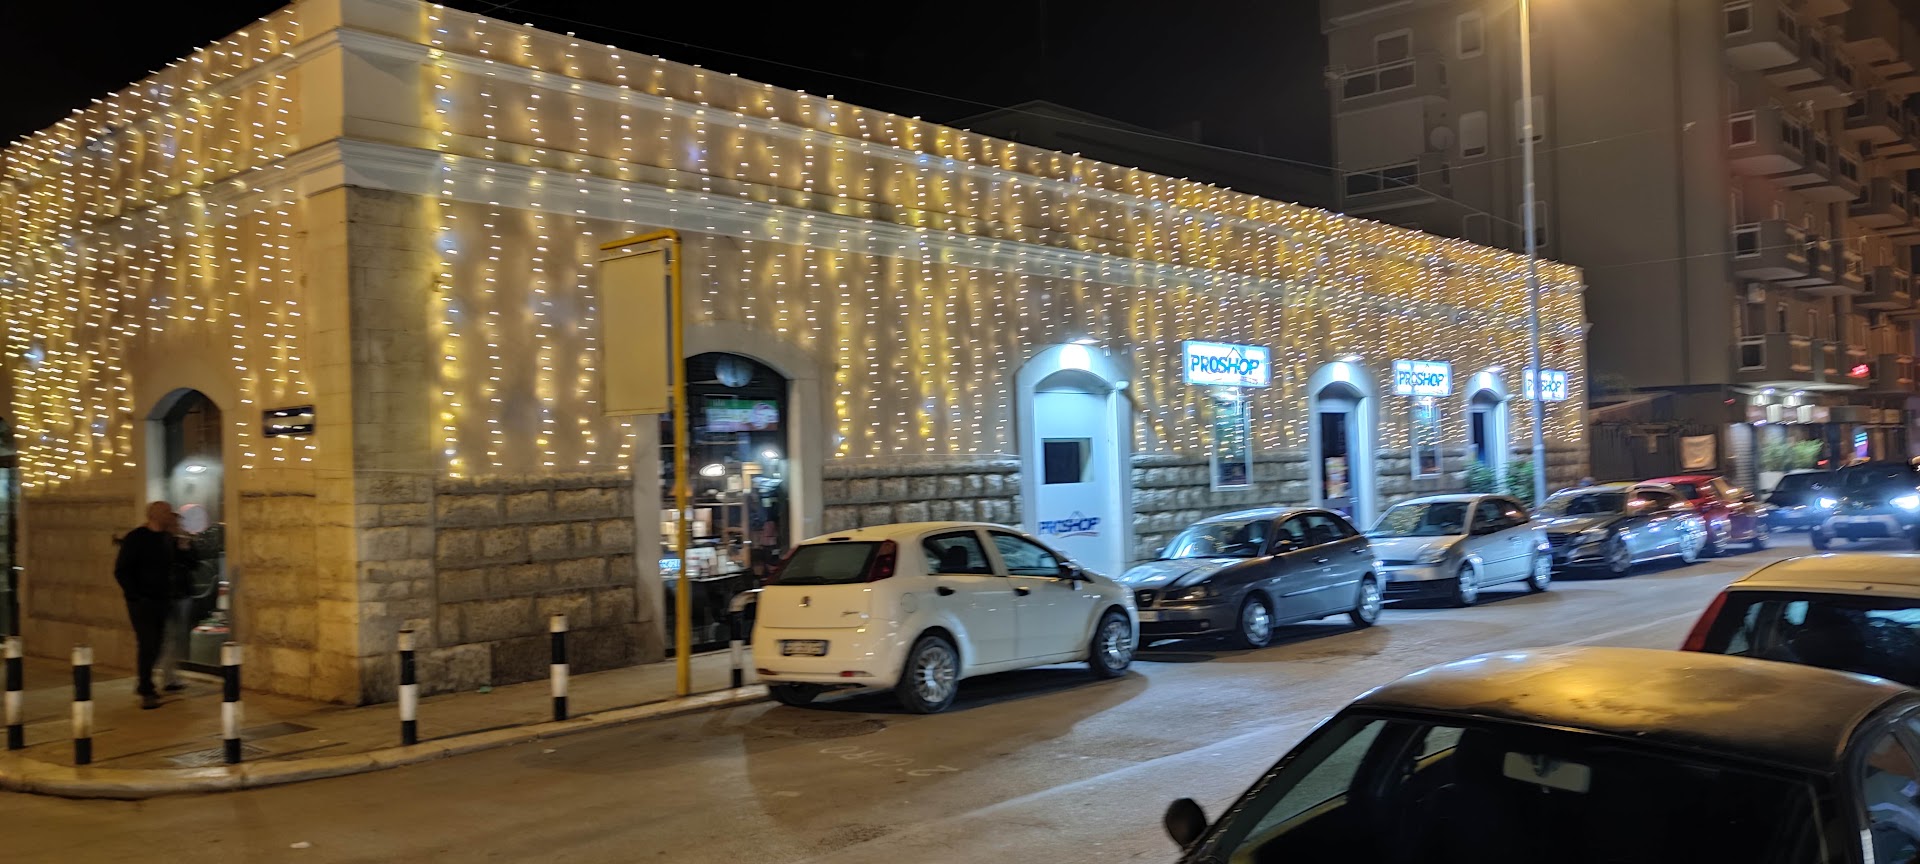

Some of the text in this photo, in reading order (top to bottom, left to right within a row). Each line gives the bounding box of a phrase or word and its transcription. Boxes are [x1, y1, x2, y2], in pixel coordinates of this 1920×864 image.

[1191, 354, 1259, 376] PROSHOP
[1398, 370, 1445, 387] PROSHOP
[1527, 379, 1562, 392] PSHOP
[1038, 516, 1101, 535] PROSHOP
